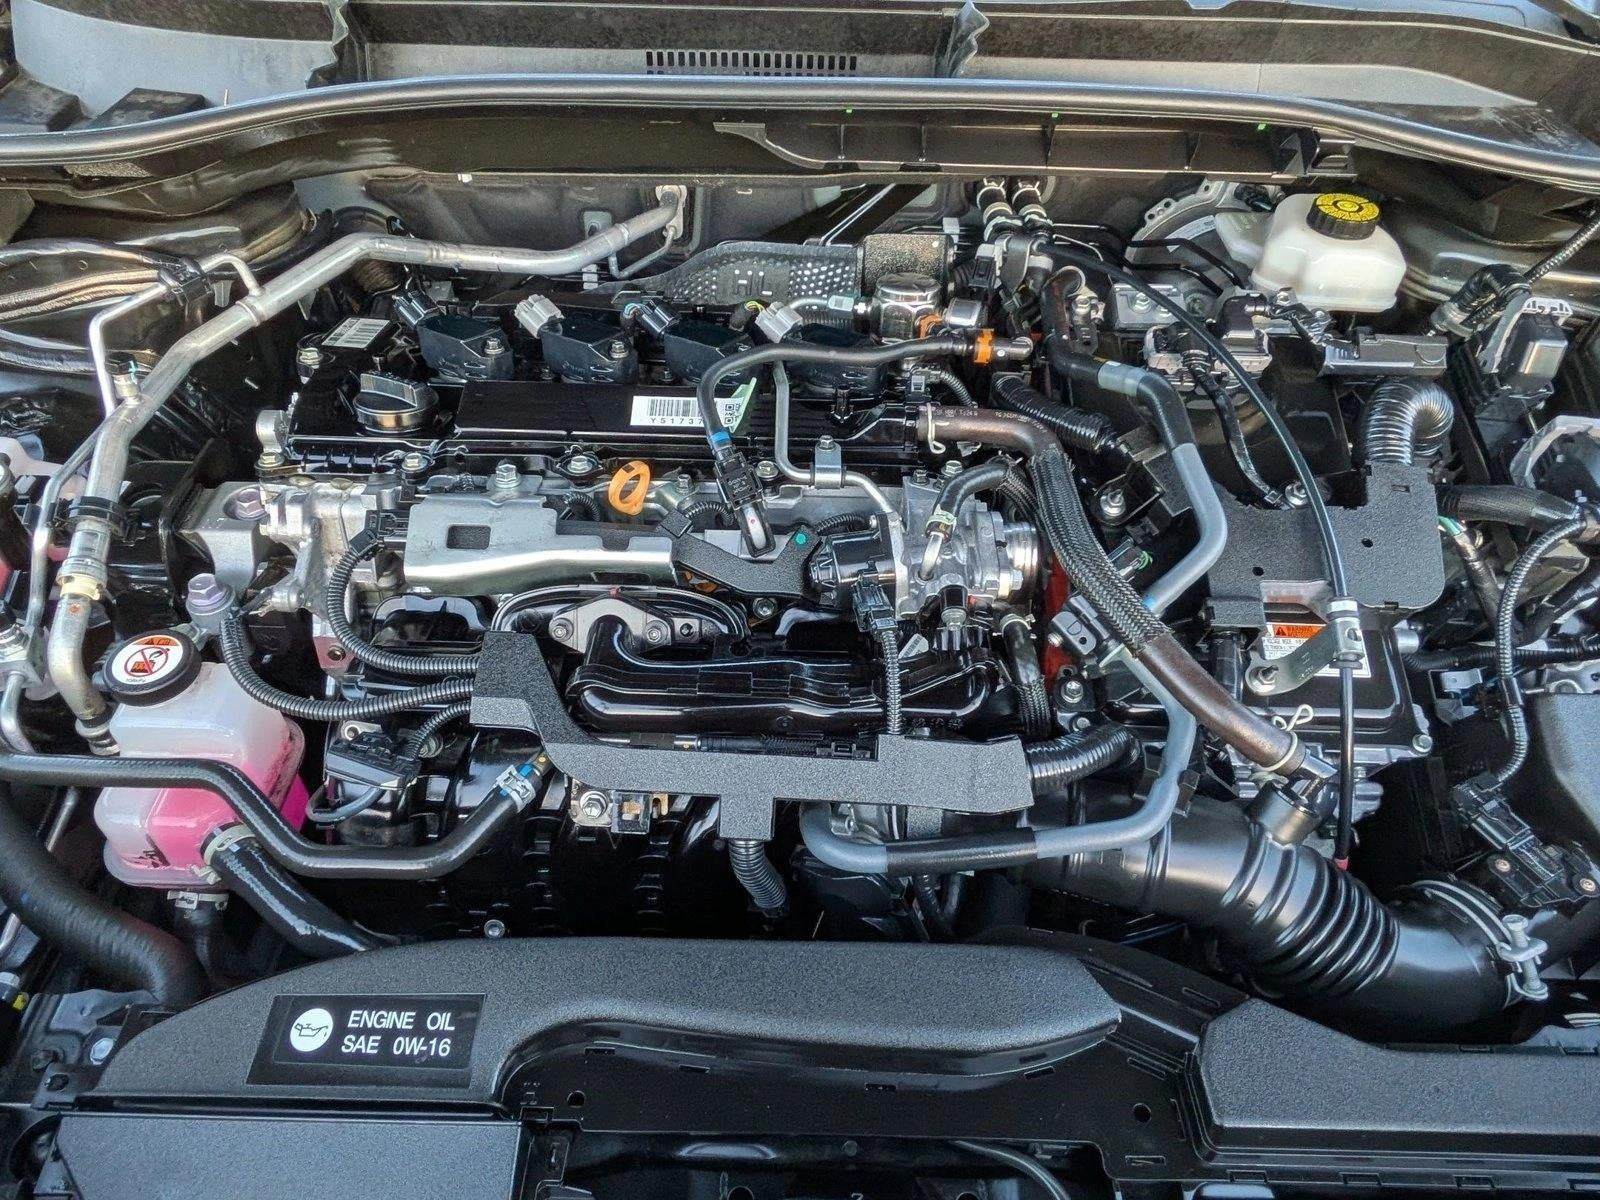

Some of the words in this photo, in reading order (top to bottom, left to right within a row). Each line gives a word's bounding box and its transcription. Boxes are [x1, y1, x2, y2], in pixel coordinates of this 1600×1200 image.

[347, 1010, 416, 1030] ENGINE
[426, 1012, 456, 1031] OIL
[341, 1035, 381, 1054] SAE
[393, 1036, 451, 1057] 0W-16
